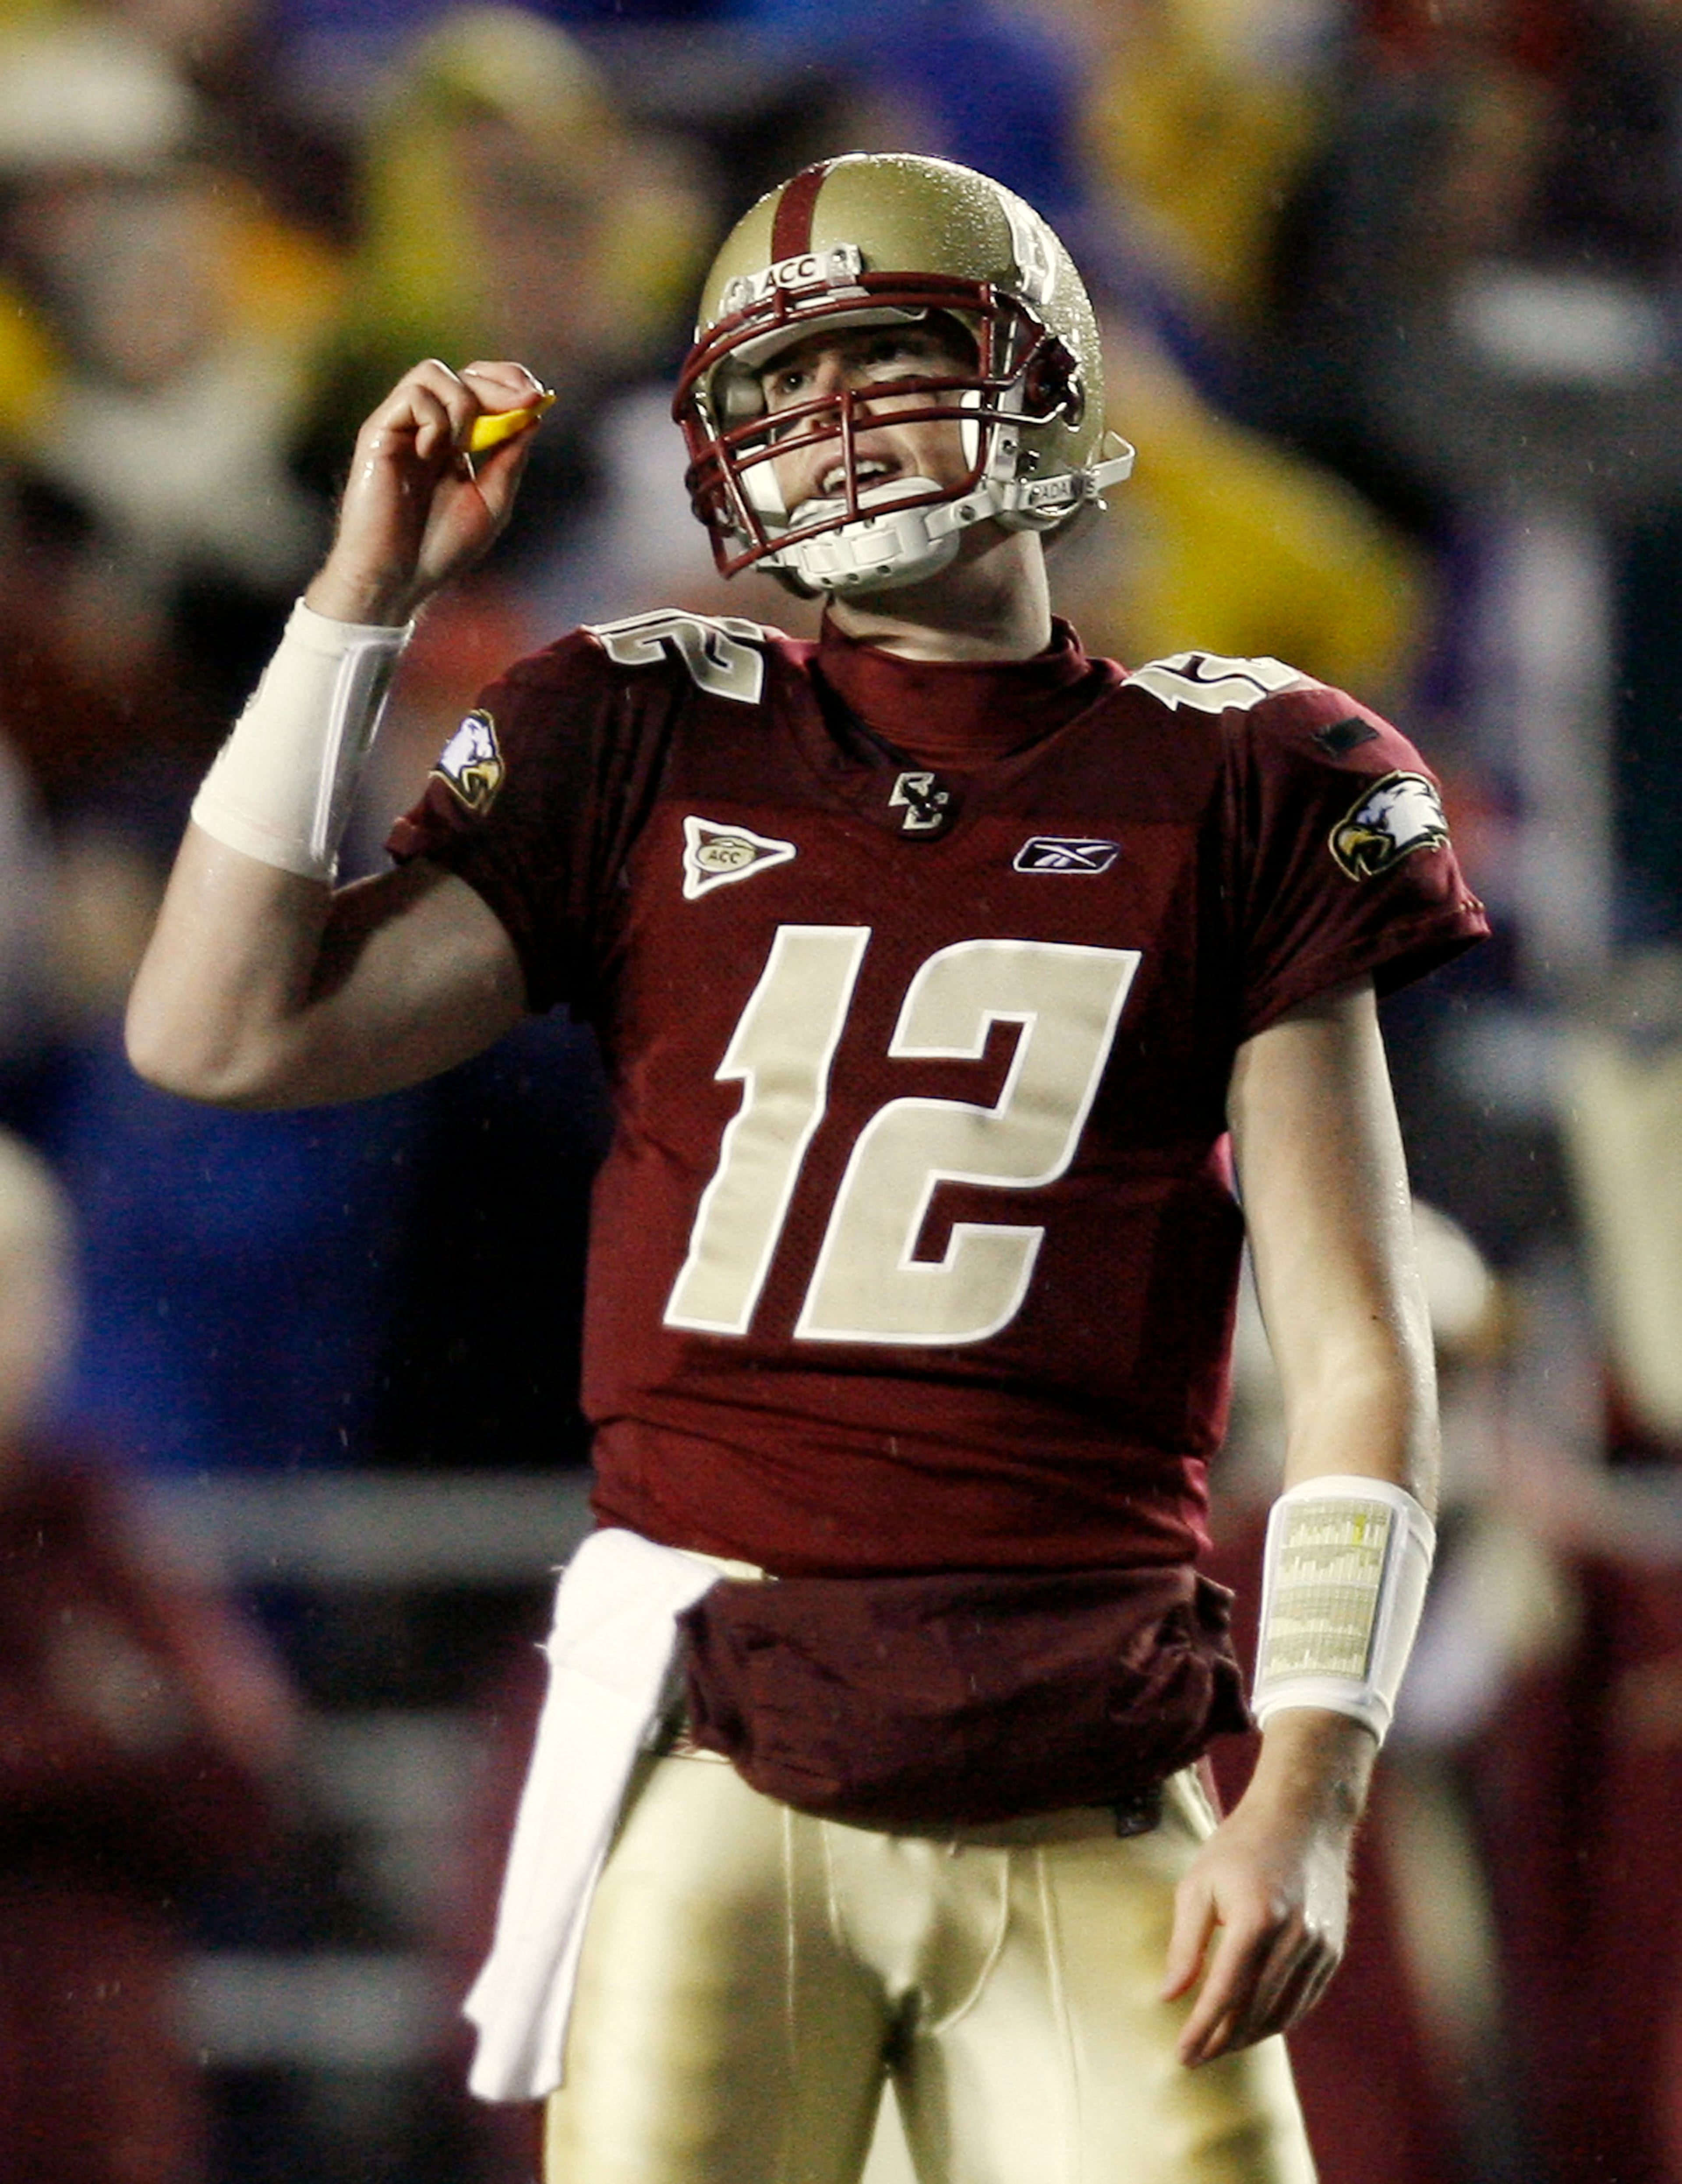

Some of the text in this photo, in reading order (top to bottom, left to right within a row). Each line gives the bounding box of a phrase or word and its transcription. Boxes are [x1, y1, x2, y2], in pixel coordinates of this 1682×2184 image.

[763, 257, 816, 289] ACC
[708, 849, 741, 864] ACC
[663, 924, 1141, 1344] 12
